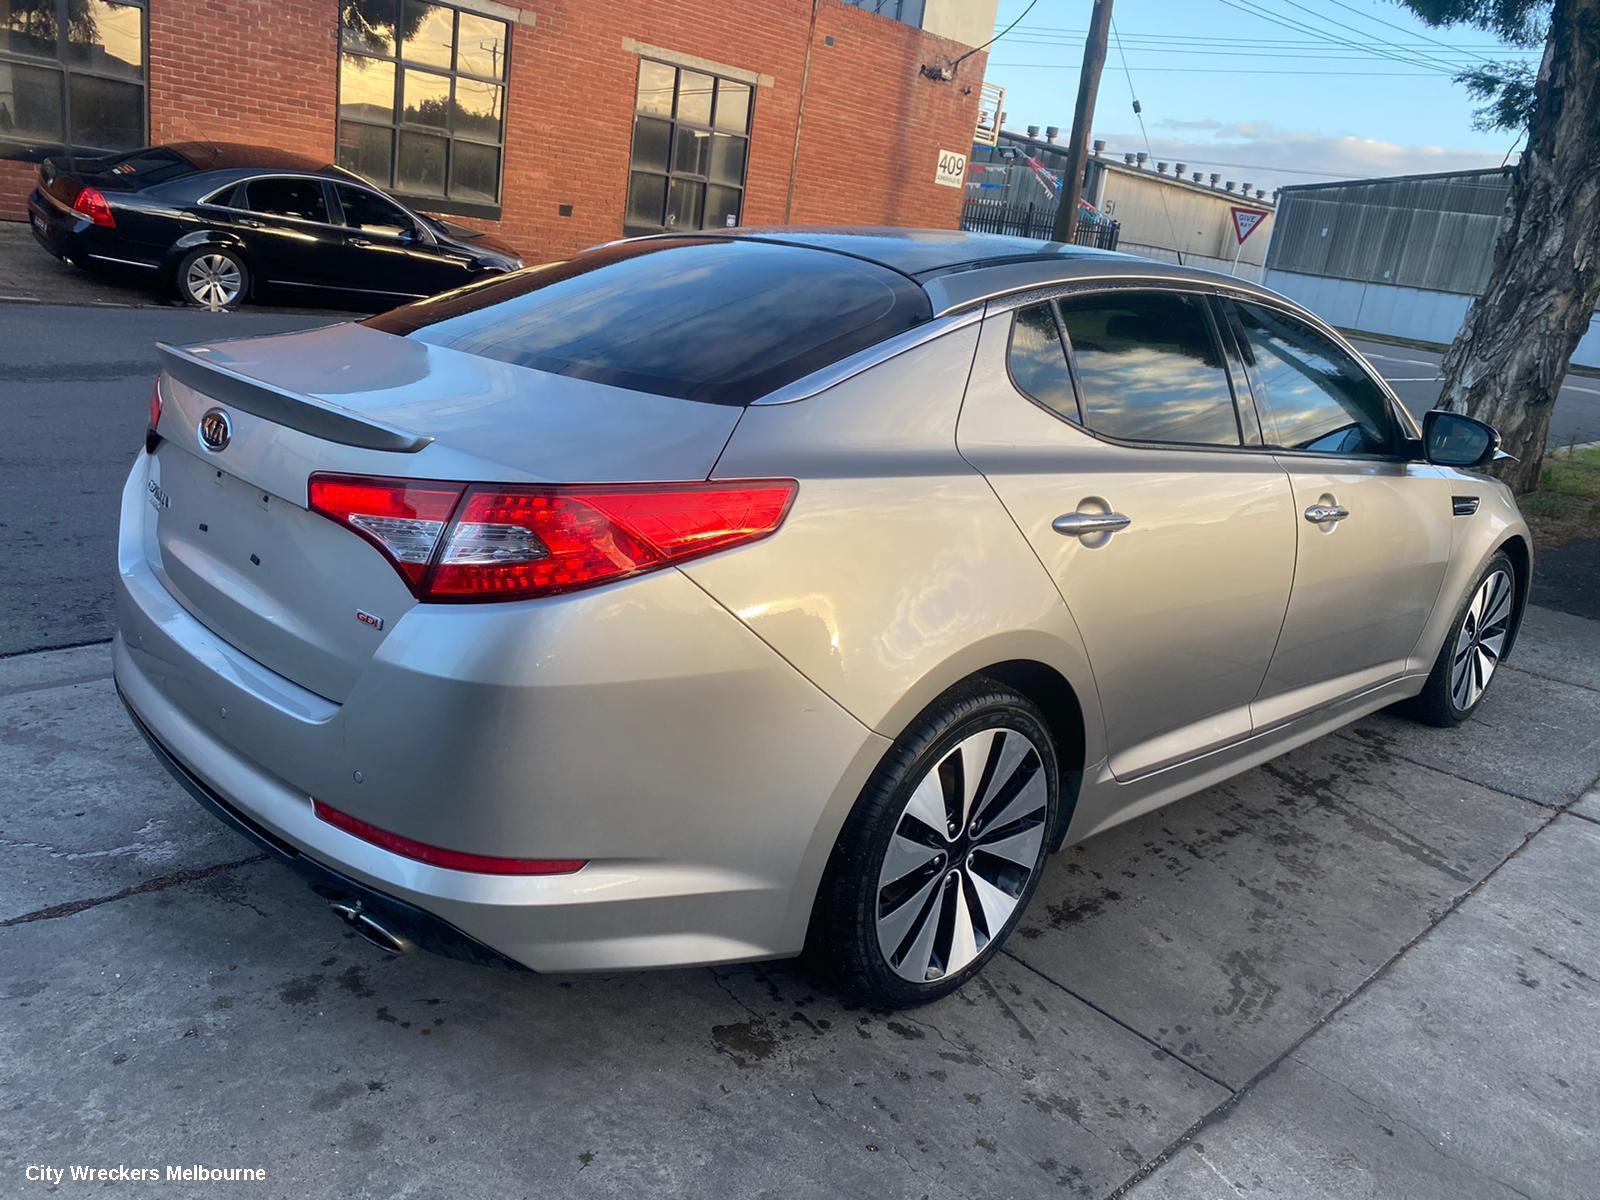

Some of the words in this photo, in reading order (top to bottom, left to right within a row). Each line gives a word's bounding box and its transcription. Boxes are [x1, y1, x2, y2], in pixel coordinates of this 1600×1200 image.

[939, 154, 964, 177] 409
[1239, 214, 1257, 223] GIVE
[356, 612, 379, 628] GDI
